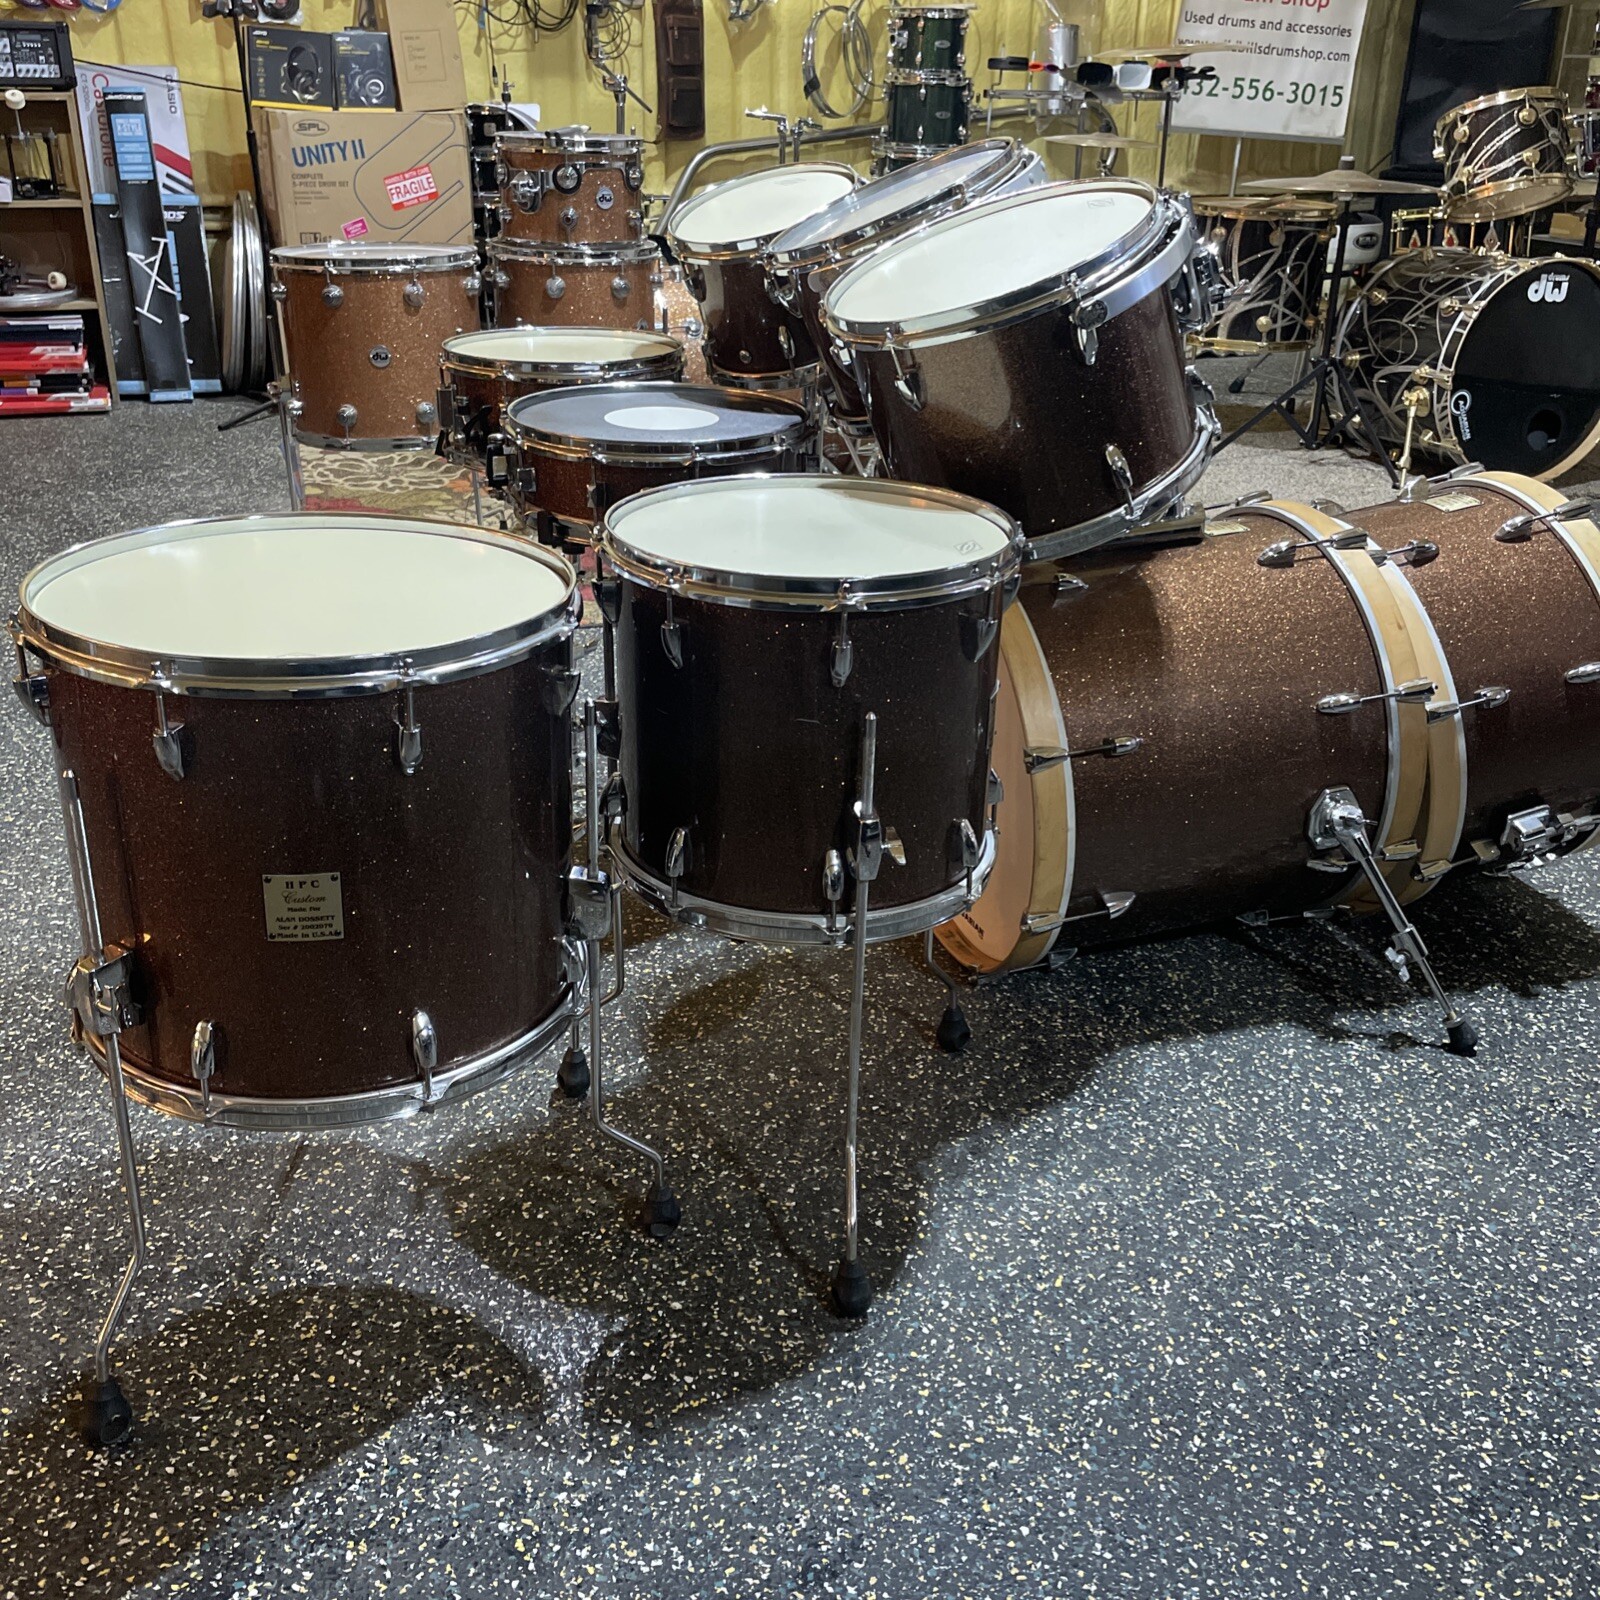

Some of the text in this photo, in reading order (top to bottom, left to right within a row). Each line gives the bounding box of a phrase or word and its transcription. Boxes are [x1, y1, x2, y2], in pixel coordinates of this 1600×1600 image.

[1184, 10, 1353, 38] Used drums and accessories
[164, 74, 178, 115] CASIO
[296, 122, 327, 132] SPL
[291, 138, 366, 168] UNITY II
[388, 177, 435, 201] FRAGILE
[598, 193, 613, 203] dw
[1527, 273, 1569, 303] dw
[371, 351, 389, 361] dw
[281, 890, 326, 904] Custom
